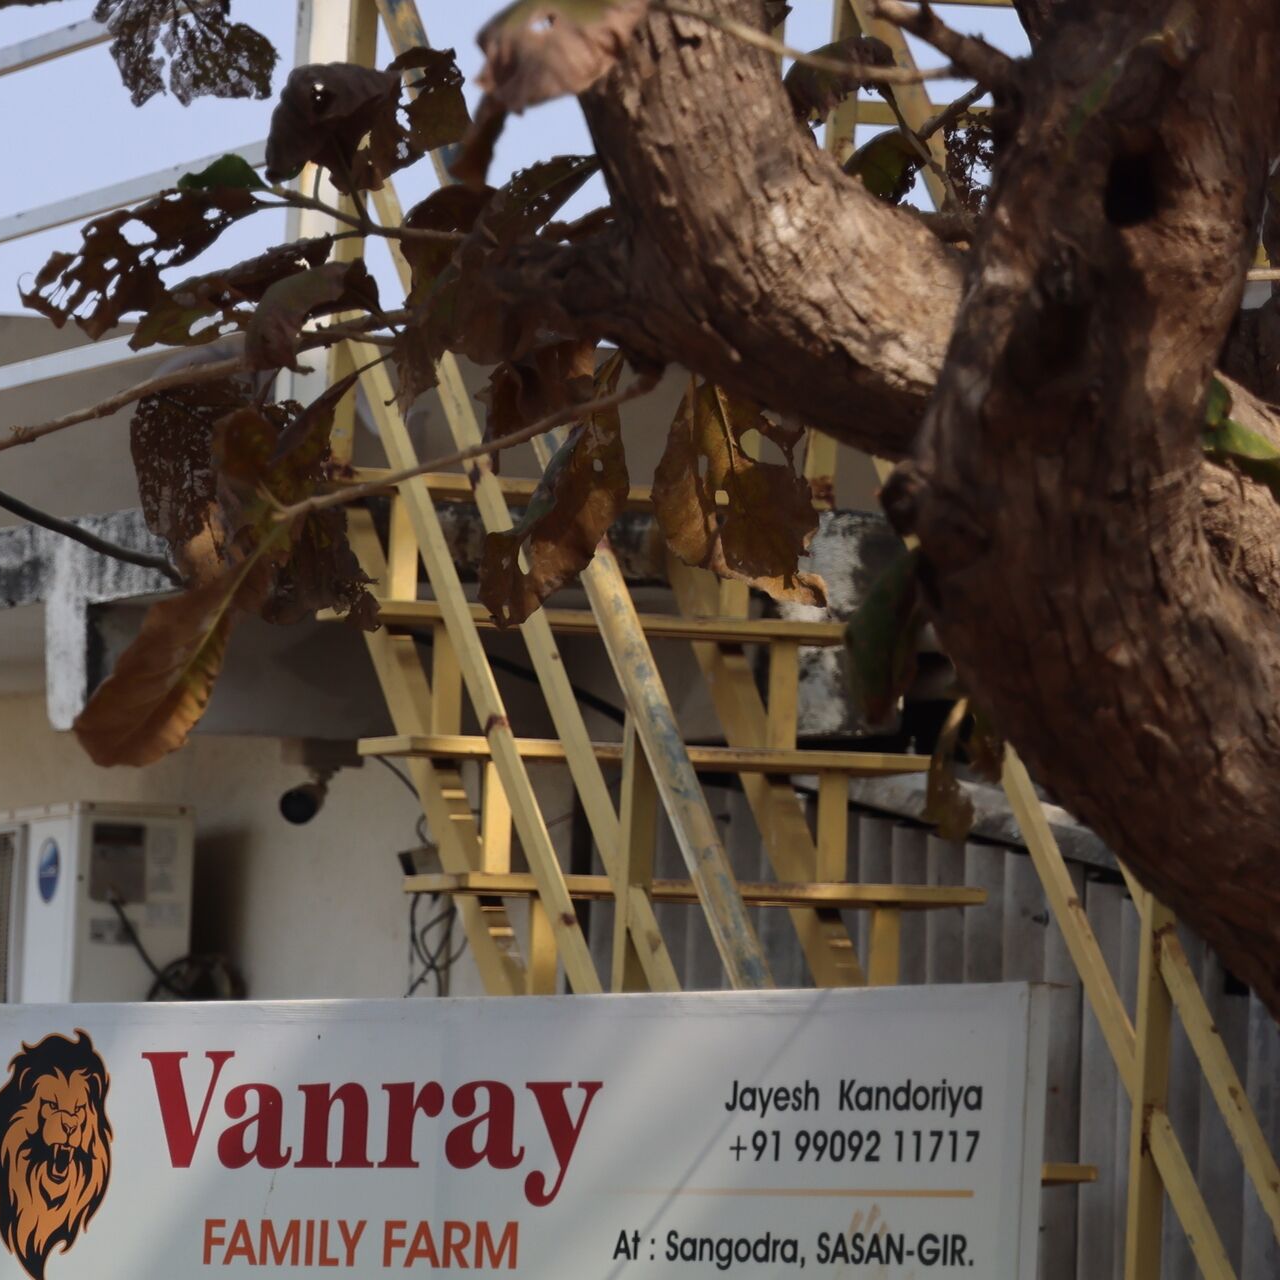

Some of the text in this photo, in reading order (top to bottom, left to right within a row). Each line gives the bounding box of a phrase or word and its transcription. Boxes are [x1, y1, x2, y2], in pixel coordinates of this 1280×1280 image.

[724, 1078, 983, 1119] Jayesh Kandoriya
[141, 1050, 604, 1208] Vanray
[729, 1129, 980, 1163] +91 99092 11717
[202, 1218, 519, 1270] FAMILY FARM
[612, 1229, 641, 1261] At
[665, 1230, 806, 1271] Sangodra,
[816, 1231, 974, 1267] SASAN-GIR.
